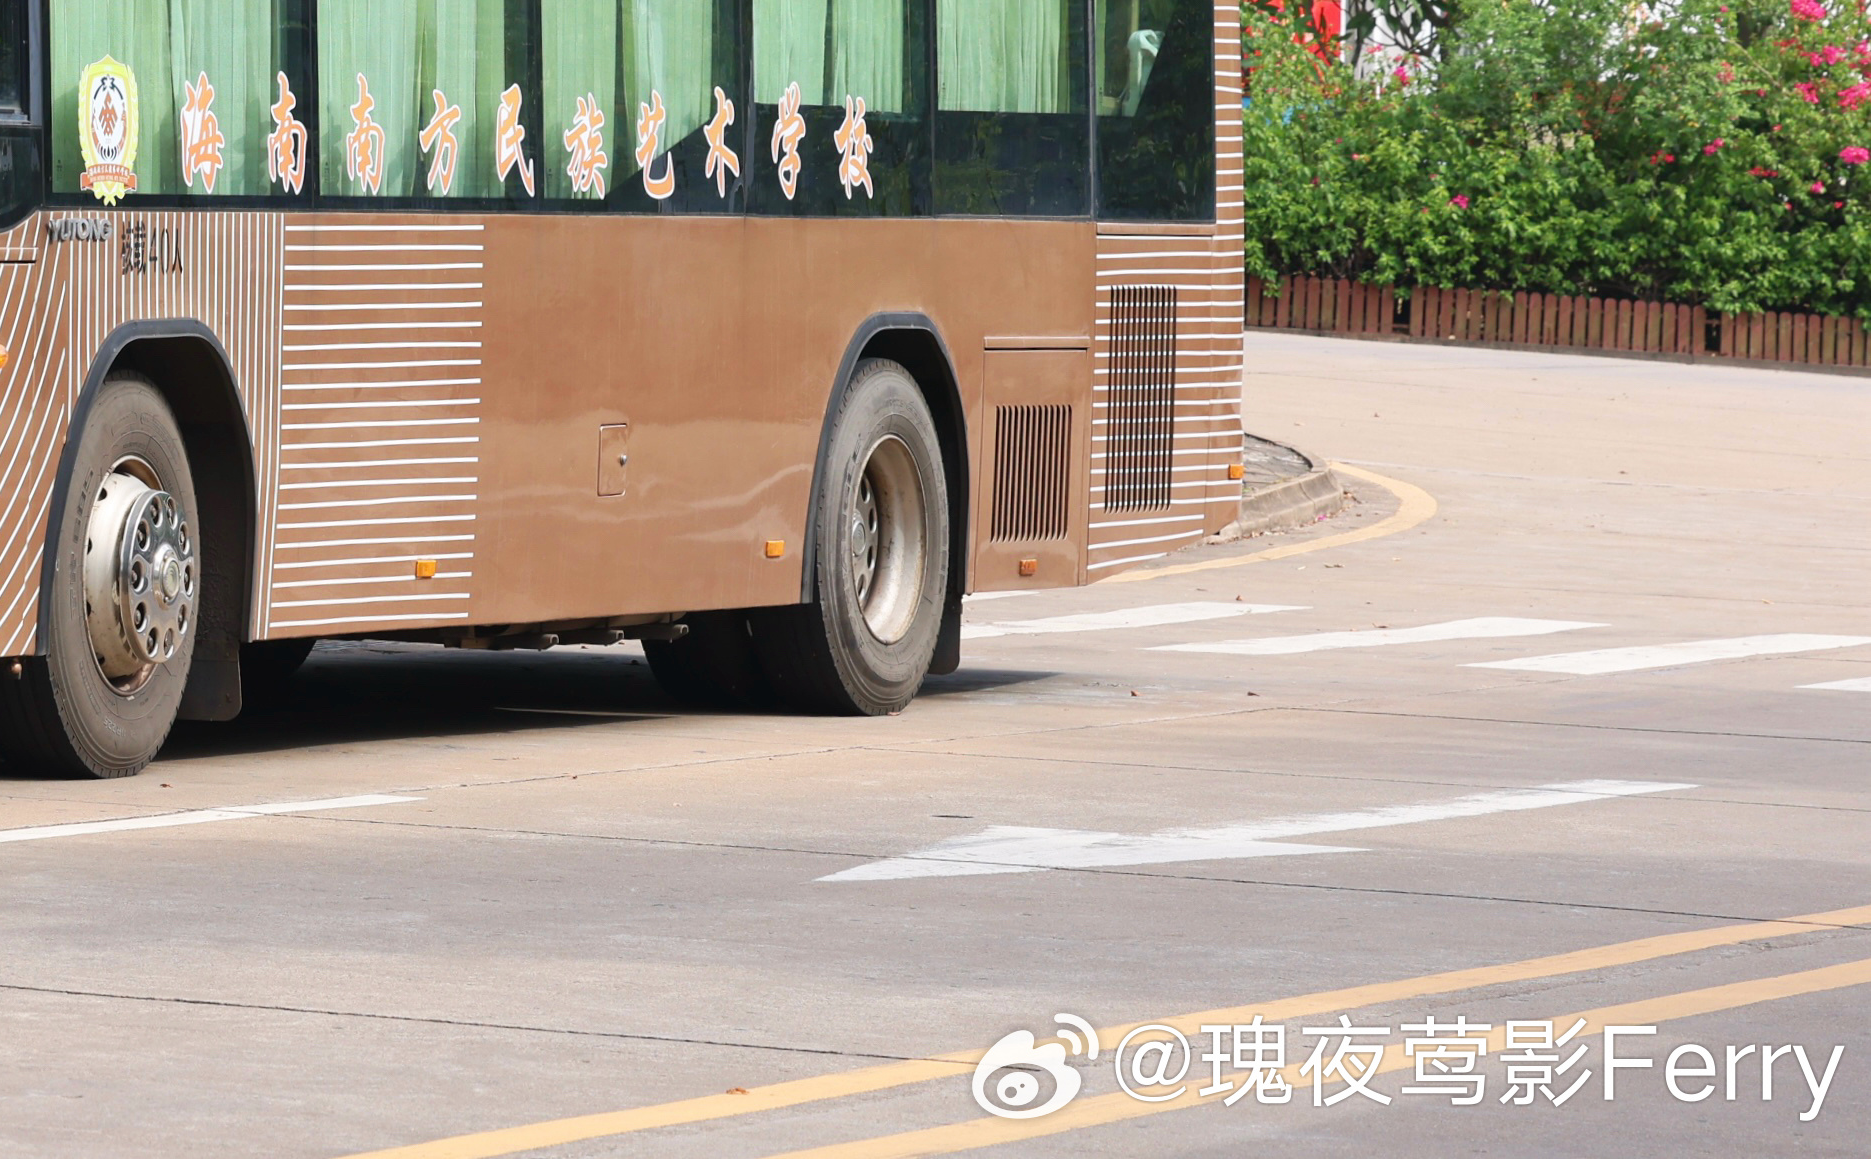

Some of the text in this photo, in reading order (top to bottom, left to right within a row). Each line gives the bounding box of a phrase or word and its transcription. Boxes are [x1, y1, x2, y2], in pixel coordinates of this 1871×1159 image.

[180, 70, 874, 201] 海南南方民族艺术学校
[48, 217, 113, 243] YUTONG
